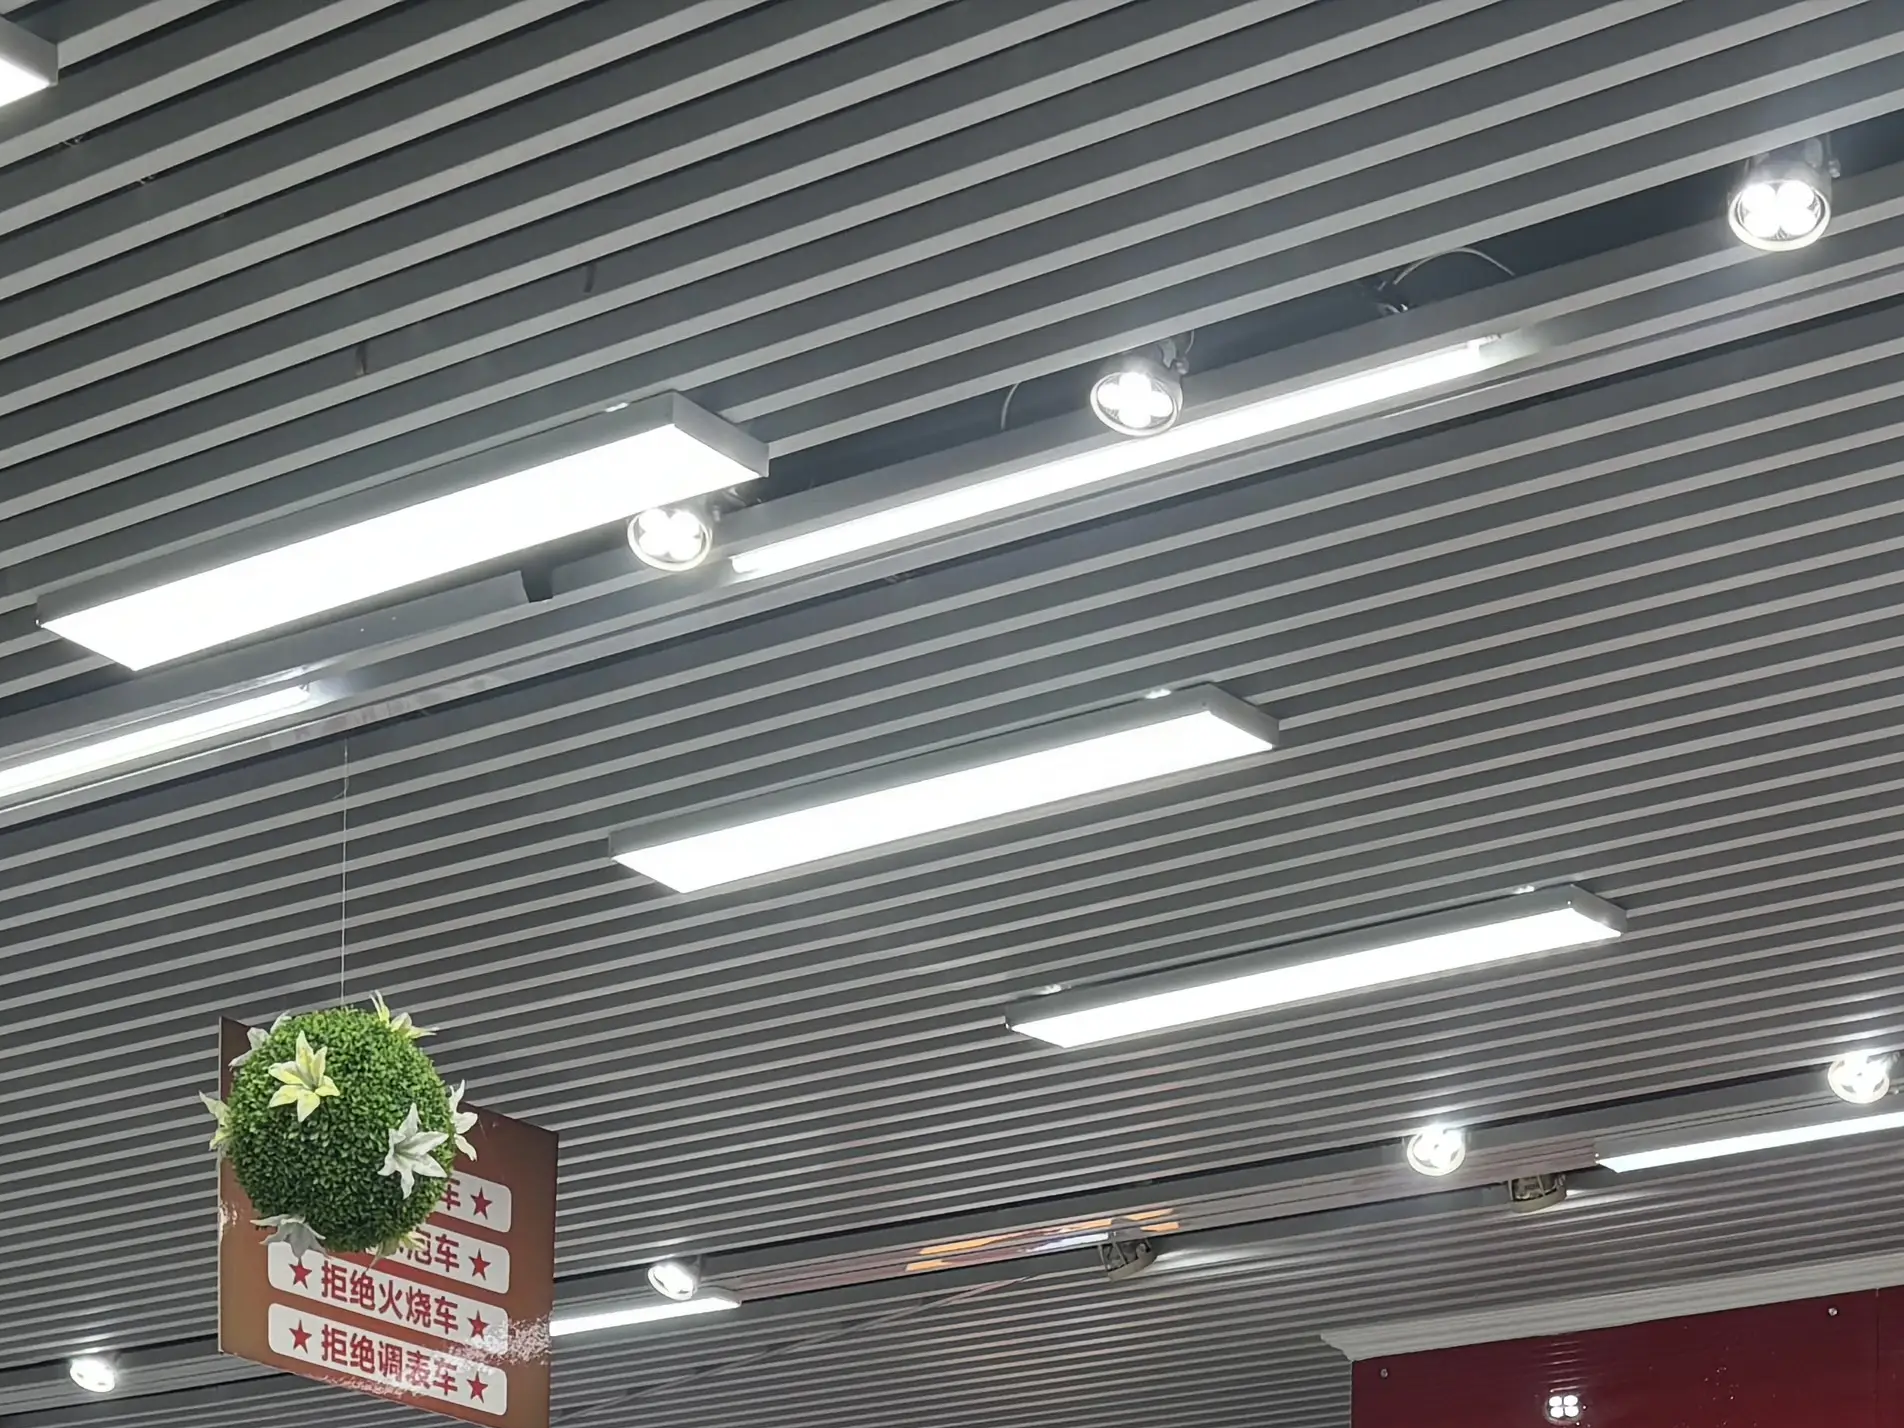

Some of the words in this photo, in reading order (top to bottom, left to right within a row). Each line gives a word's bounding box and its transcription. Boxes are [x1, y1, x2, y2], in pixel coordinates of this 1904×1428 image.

[321, 1260, 458, 1335] 拒绝火烧车
[321, 1324, 458, 1397] 拒绝调表车
